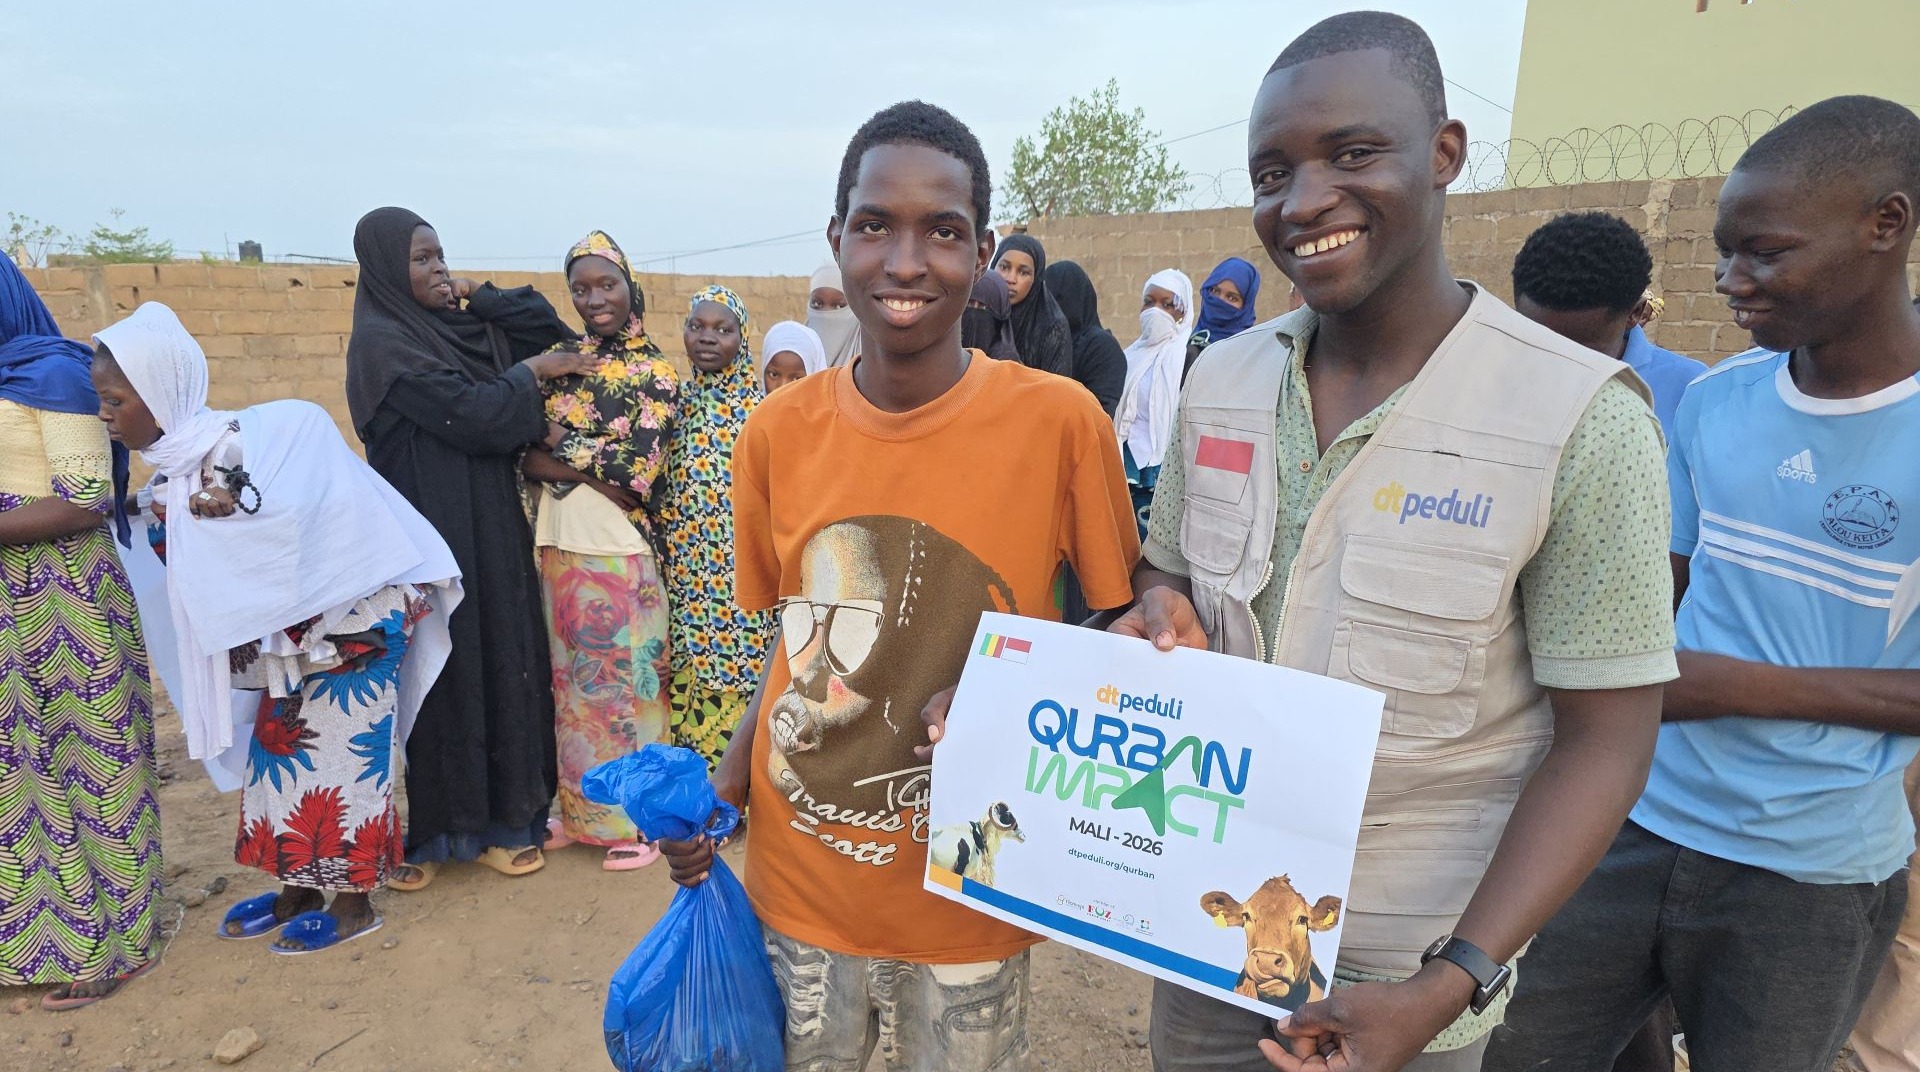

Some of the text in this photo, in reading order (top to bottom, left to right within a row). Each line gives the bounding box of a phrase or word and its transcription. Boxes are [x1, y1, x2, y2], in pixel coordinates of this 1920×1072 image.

[1776, 465, 1817, 484] sports
[1372, 480, 1494, 529] dtpeduli
[1826, 516, 1852, 540] ALOU
[1853, 528, 1890, 543] KEITA
[1096, 684, 1184, 720] dtpeduli
[1028, 699, 1253, 796] QURBAN
[1024, 746, 1246, 845] IMPACT
[789, 810, 899, 867] Scott
[1068, 816, 1111, 841] MALI
[1122, 830, 1164, 857] 2026
[1068, 847, 1156, 881] dtpeduli.org/qurban
